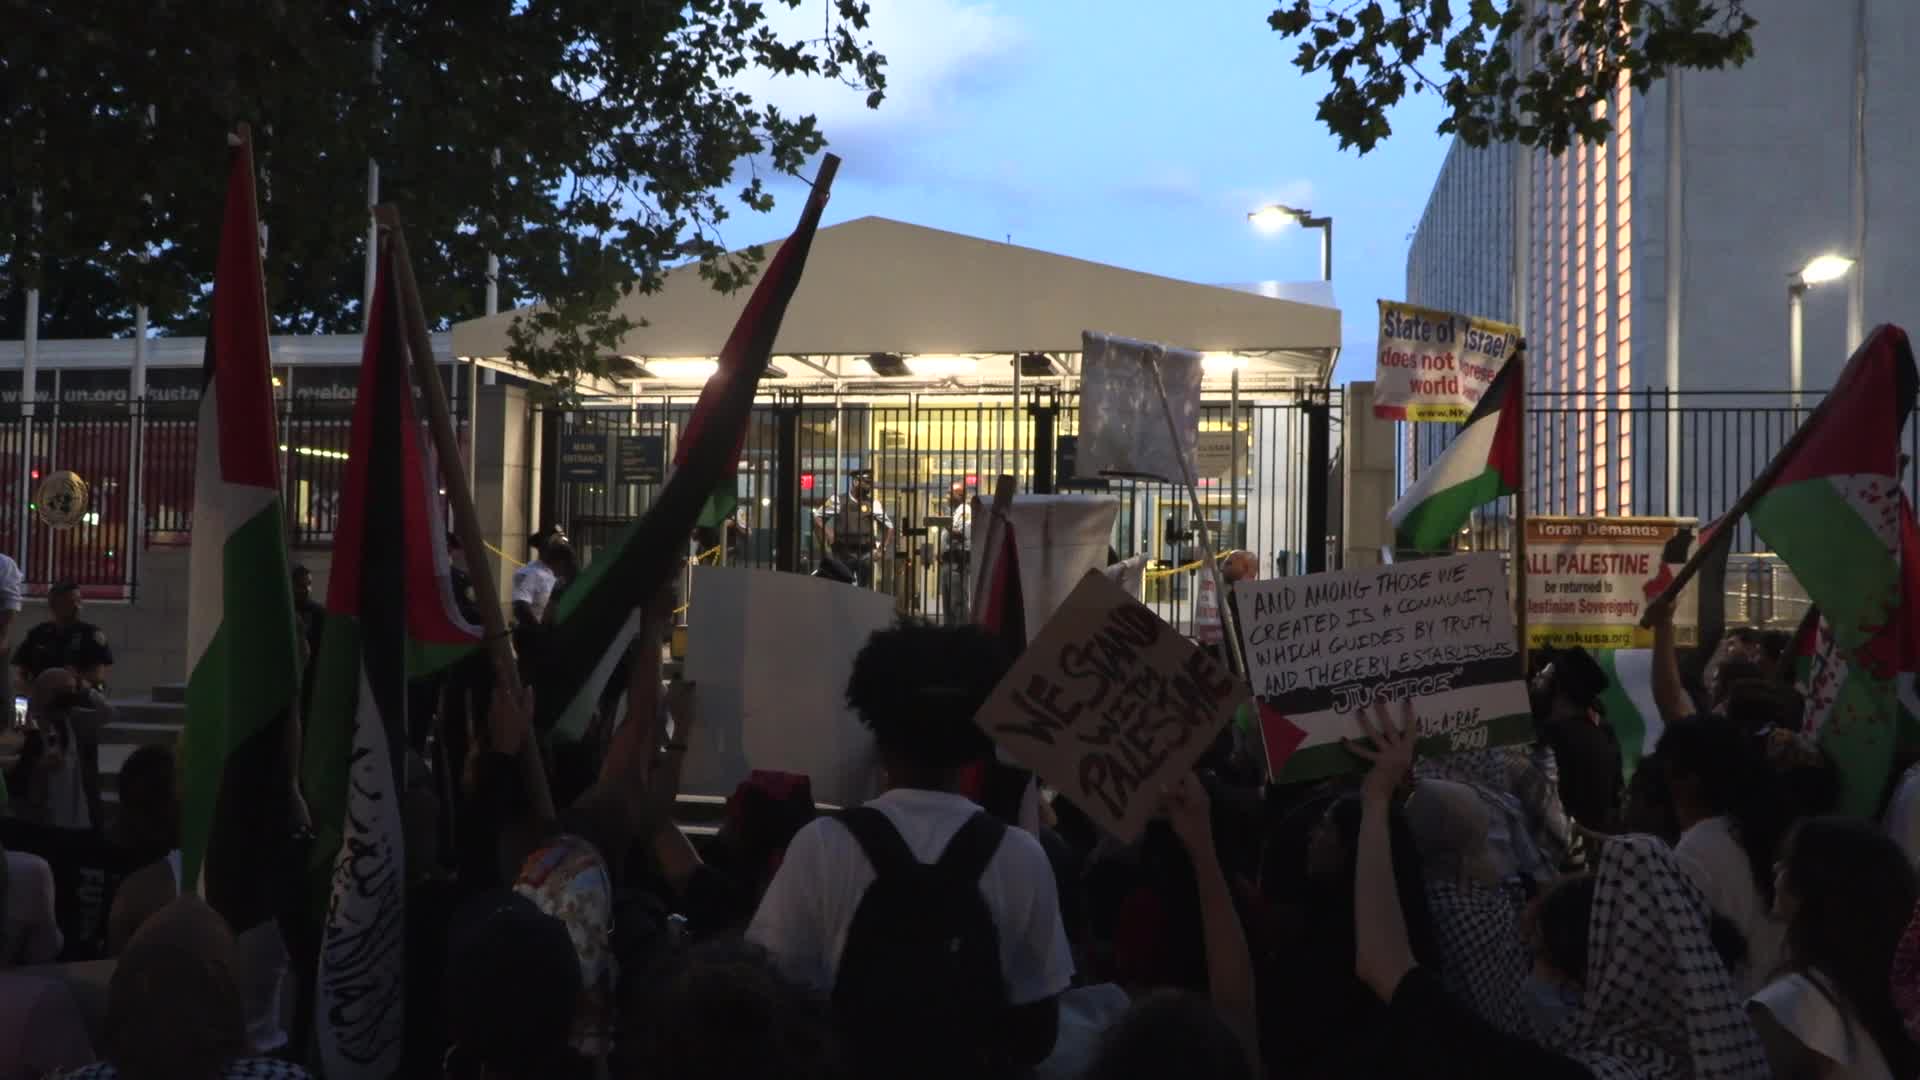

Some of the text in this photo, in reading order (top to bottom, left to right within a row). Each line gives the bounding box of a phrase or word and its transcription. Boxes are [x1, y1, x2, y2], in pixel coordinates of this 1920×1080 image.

[1384, 310, 1431, 342] State
[1436, 316, 1455, 343] of
[1381, 347, 1417, 369] does
[1421, 352, 1455, 371] not
[1410, 376, 1459, 396] world
[1537, 521, 1659, 537] Torah Demands
[1556, 552, 1649, 575] PALESTINE
[1304, 579, 1372, 609] AMONG
[1376, 570, 1432, 597] THOSE
[1438, 563, 1469, 584] WE
[1544, 578, 1613, 593] be returned to
[1250, 586, 1495, 646] CREATED IS A COMMUNITY
[1528, 598, 1640, 617] lestinian Sovereignty
[1256, 614, 1492, 667] WHICH GUIDES BY TRUTH
[1530, 631, 1631, 646] www.nkusa.org
[995, 603, 1159, 744] WE STAND
[1265, 642, 1514, 697] AND THEREBY ESTABLISHES
